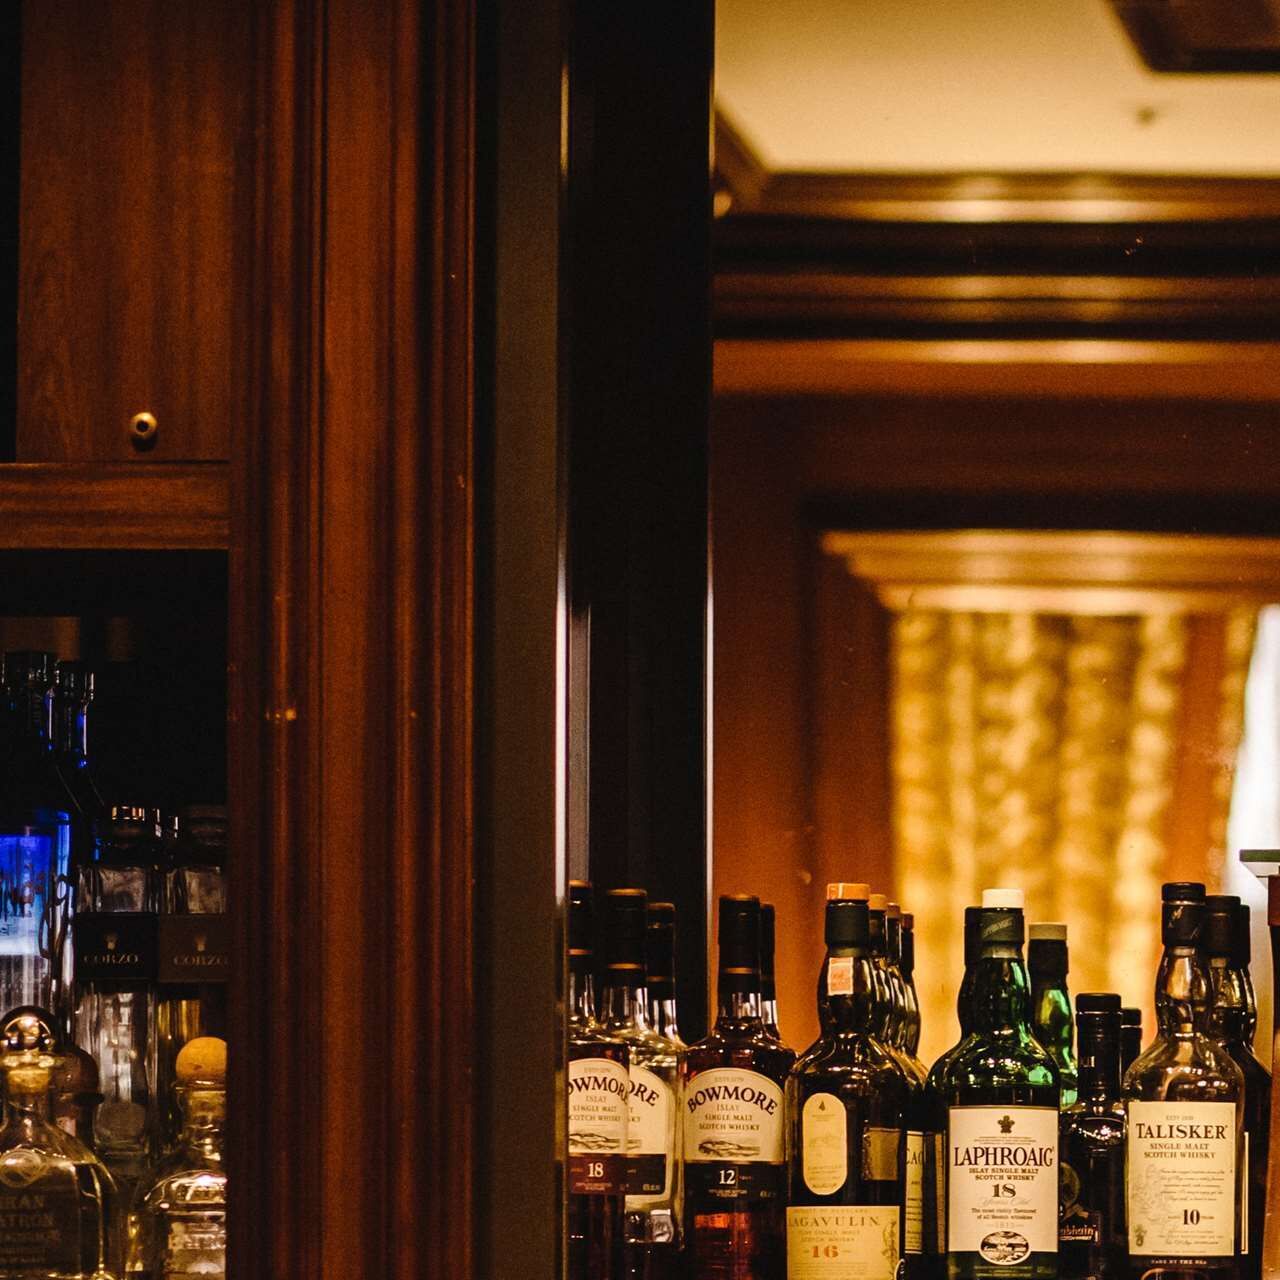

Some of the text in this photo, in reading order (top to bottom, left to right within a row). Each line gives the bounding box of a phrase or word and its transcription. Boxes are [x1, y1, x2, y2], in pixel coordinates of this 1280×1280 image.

[686, 1085, 779, 1116] BOWMORE
[1136, 1122, 1224, 1139] TALISKER
[954, 1146, 1054, 1167] LAPHROAIG
[1143, 1151, 1216, 1159] SCOTCH WHISKY
[587, 1162, 604, 1178] 18
[719, 1169, 736, 1185] 12
[991, 1183, 1017, 1198] 18
[1183, 1208, 1200, 1226] 10
[812, 1245, 839, 1259] 16
